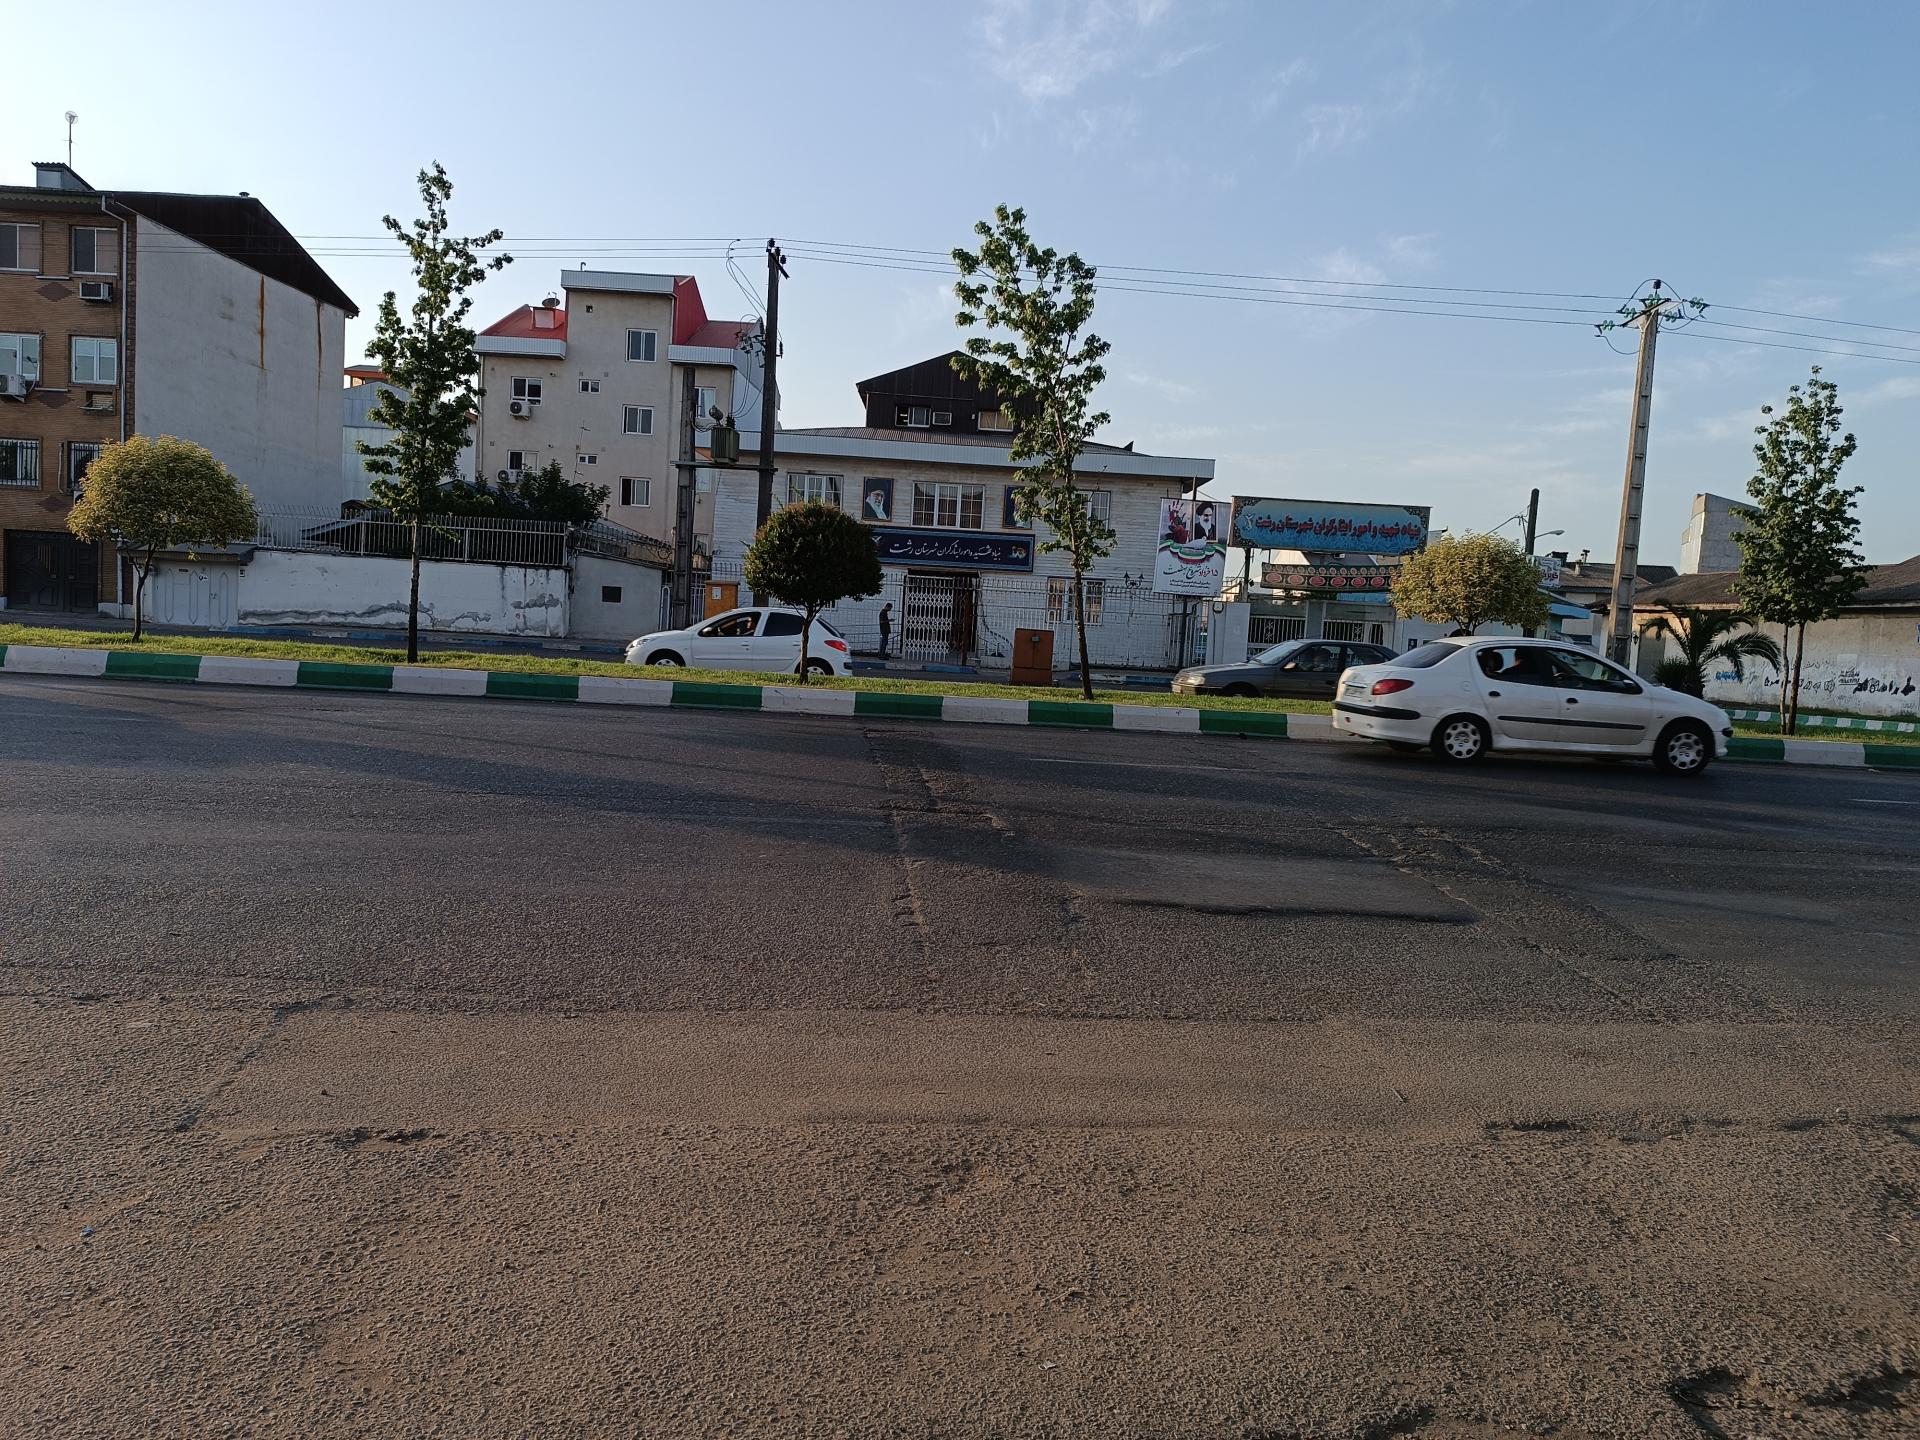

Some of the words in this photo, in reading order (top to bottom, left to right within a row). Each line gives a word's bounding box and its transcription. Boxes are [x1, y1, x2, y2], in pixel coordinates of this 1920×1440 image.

[1256, 514, 1276, 534] رشت
[1276, 514, 1314, 534] شهرستان
[1378, 521, 1400, 538] شهید
[1401, 521, 1421, 540] بنیاد
[889, 539, 914, 555] رشت
[914, 541, 938, 555] شهرستان
[972, 544, 992, 559] شهید
